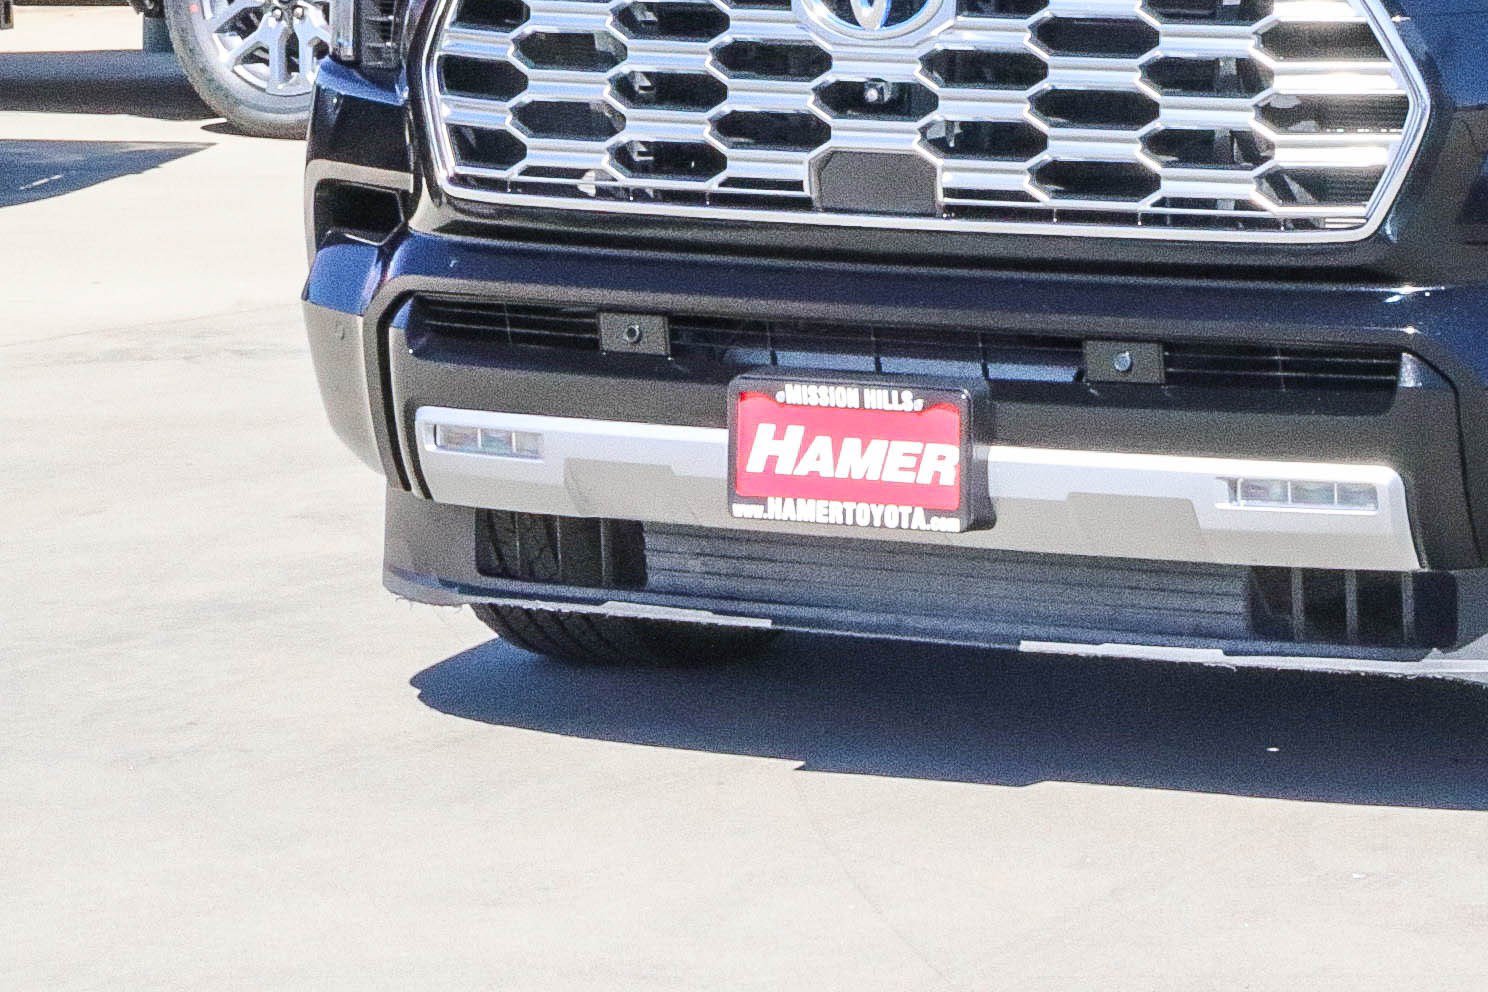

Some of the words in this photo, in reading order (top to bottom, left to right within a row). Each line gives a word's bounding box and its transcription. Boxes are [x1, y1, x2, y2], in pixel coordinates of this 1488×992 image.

[785, 383, 859, 409] MISSION
[864, 388, 914, 412] HILLS
[746, 423, 961, 486] HAMER
[732, 496, 961, 533] www.HAMERTOYOTA.com
